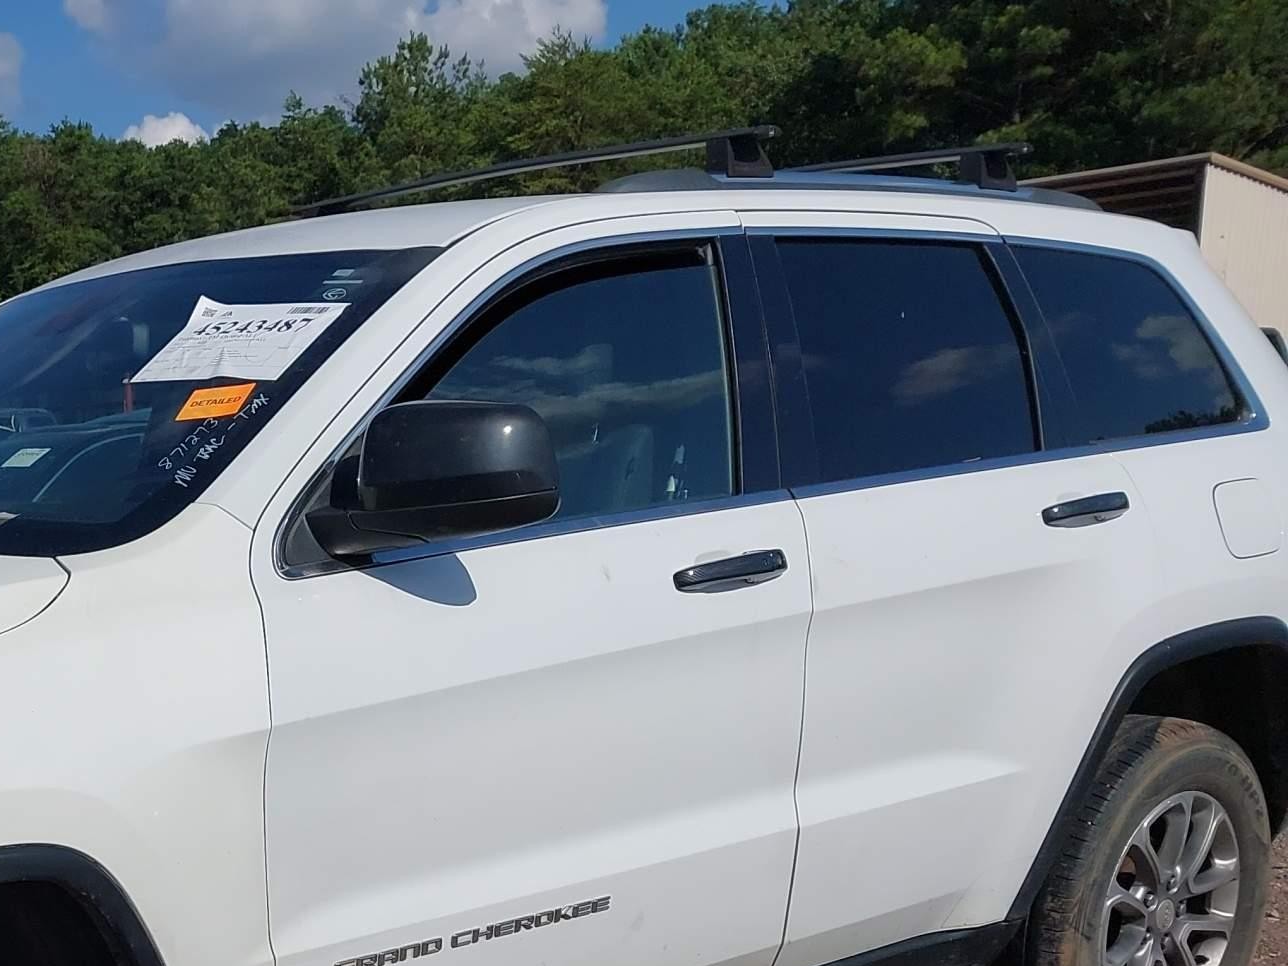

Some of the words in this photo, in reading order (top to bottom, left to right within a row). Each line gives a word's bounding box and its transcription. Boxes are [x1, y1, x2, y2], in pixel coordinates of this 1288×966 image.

[193, 318, 315, 336] 45243487
[189, 396, 242, 408] DETAILED
[158, 417, 219, 470] 871273
[450, 895, 612, 949] CHEROKEE
